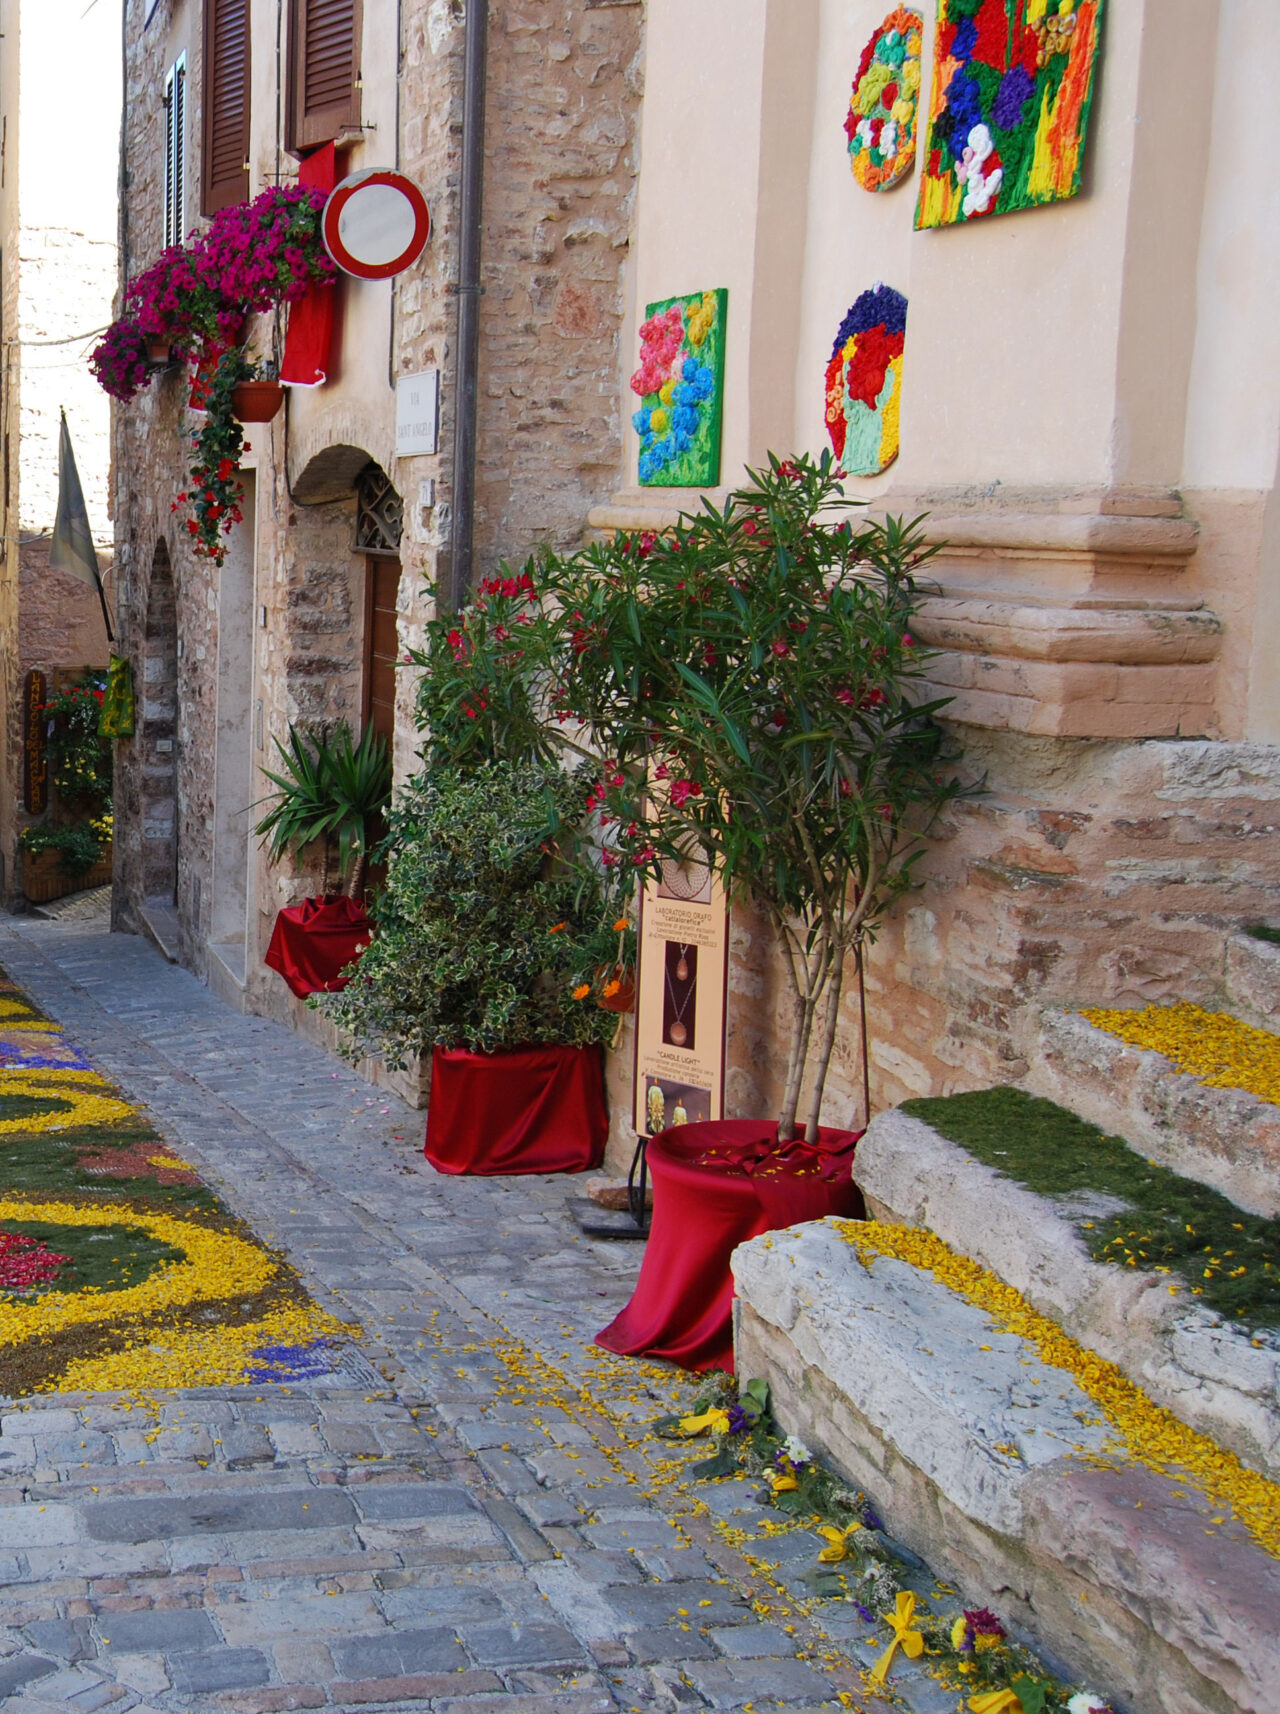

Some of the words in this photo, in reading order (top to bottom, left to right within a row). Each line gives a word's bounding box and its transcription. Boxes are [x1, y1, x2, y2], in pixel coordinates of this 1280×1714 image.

[410, 391, 420, 406] VIA
[656, 907, 691, 918] LABORATORIO
[693, 912, 712, 921] ORAFO
